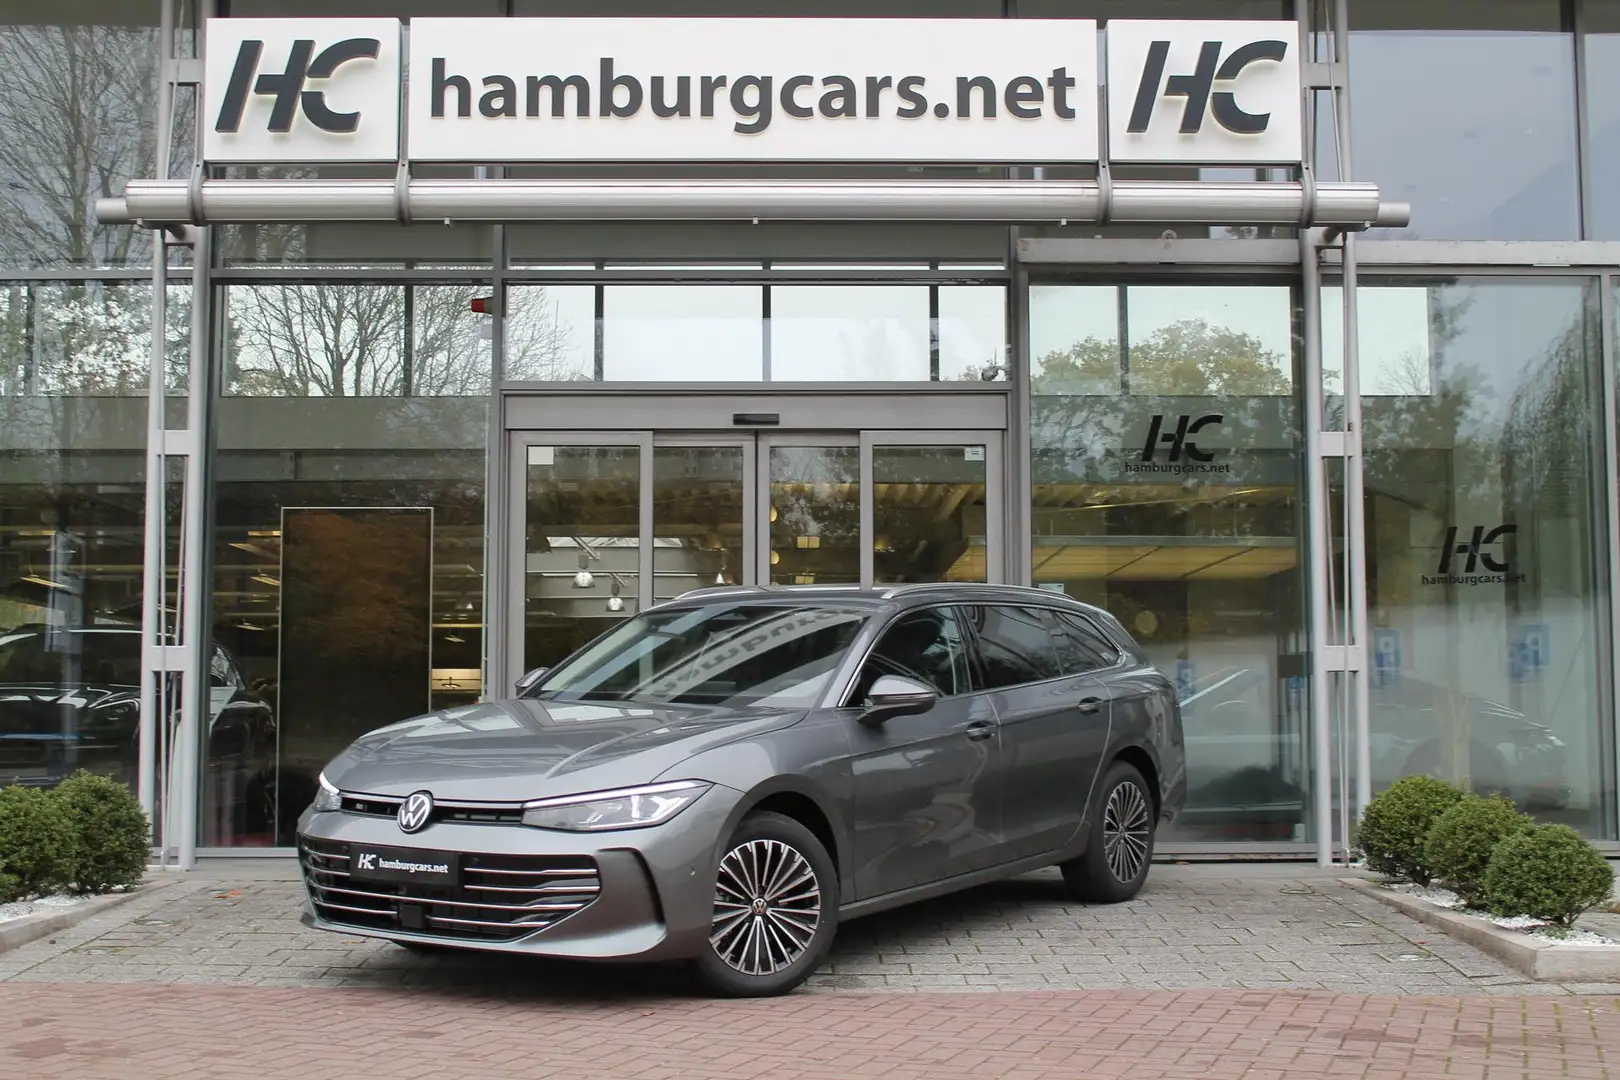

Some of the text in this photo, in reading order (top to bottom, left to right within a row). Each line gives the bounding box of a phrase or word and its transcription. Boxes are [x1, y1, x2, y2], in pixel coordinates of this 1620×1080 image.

[215, 37, 381, 134] HC
[430, 57, 1076, 135] hamburgcars.net
[1126, 39, 1288, 135] HC
[1141, 414, 1224, 462] HC
[1124, 461, 1230, 475] hamburgcars.net
[1438, 524, 1518, 574] HC
[1421, 574, 1526, 586] hamburgcars.et
[357, 853, 448, 873] HC hamburgcars.net
